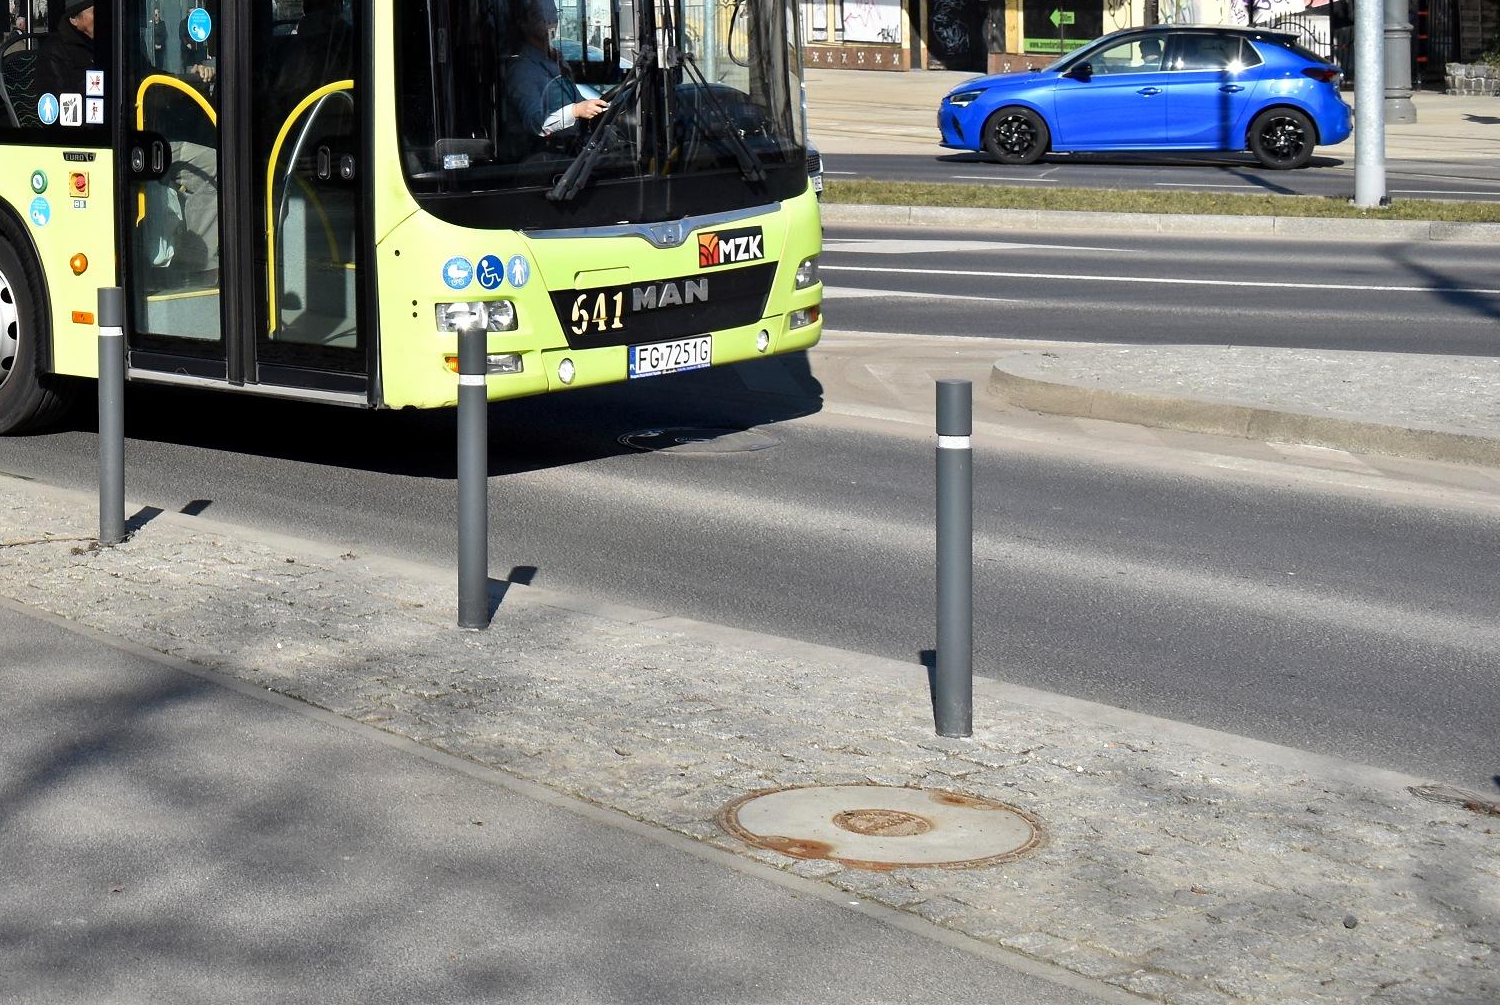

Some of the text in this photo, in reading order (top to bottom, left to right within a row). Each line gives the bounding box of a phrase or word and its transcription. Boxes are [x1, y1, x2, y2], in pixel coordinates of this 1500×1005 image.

[717, 234, 764, 264] MZK
[632, 278, 709, 312] MAN
[571, 291, 624, 335] 641
[638, 339, 708, 371] FG 7251G
